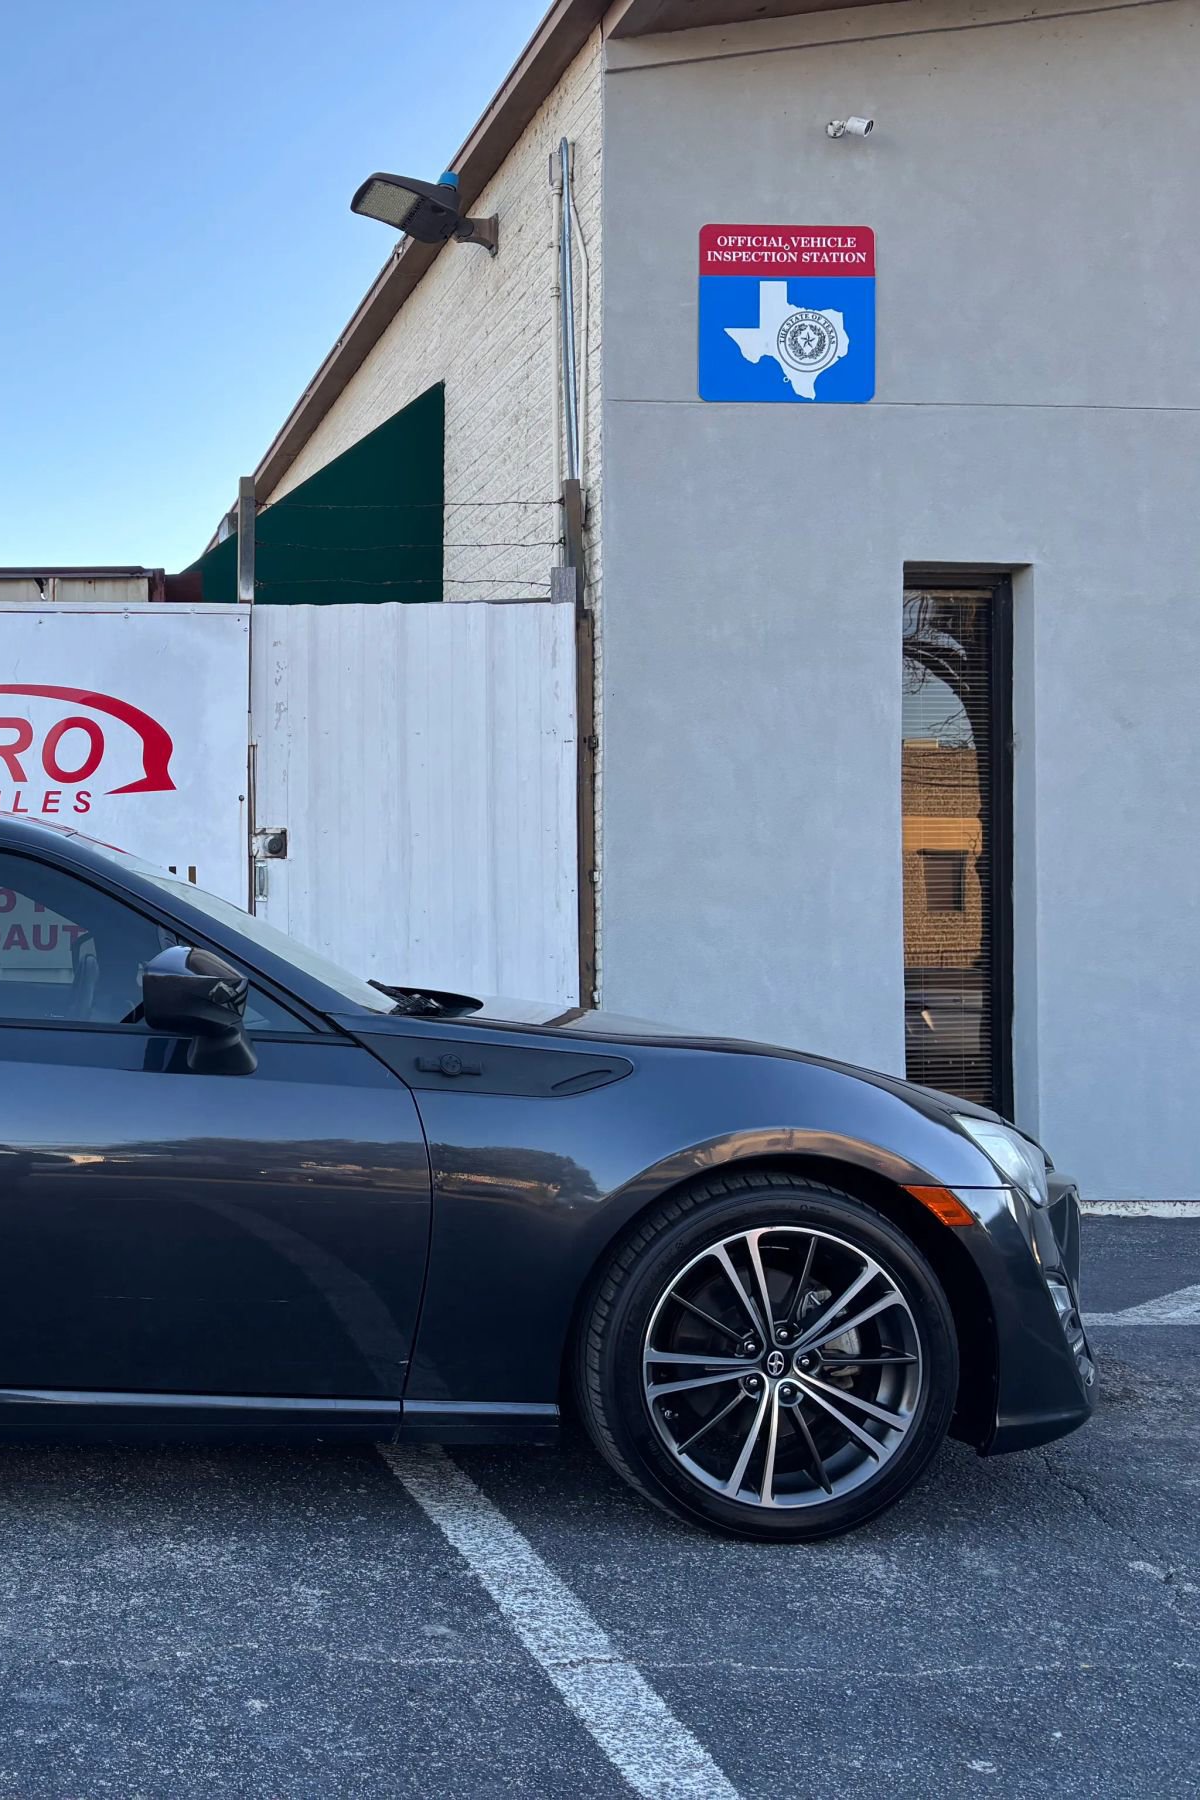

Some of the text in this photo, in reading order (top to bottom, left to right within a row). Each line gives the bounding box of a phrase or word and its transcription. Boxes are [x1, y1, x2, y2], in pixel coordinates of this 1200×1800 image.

[716, 235, 857, 248] OFFICIAL VEHICLE
[707, 251, 867, 264] INSPECTION STATION
[779, 327, 789, 344] THE
[786, 313, 810, 327] STATE
[822, 320, 836, 345] TEXAS
